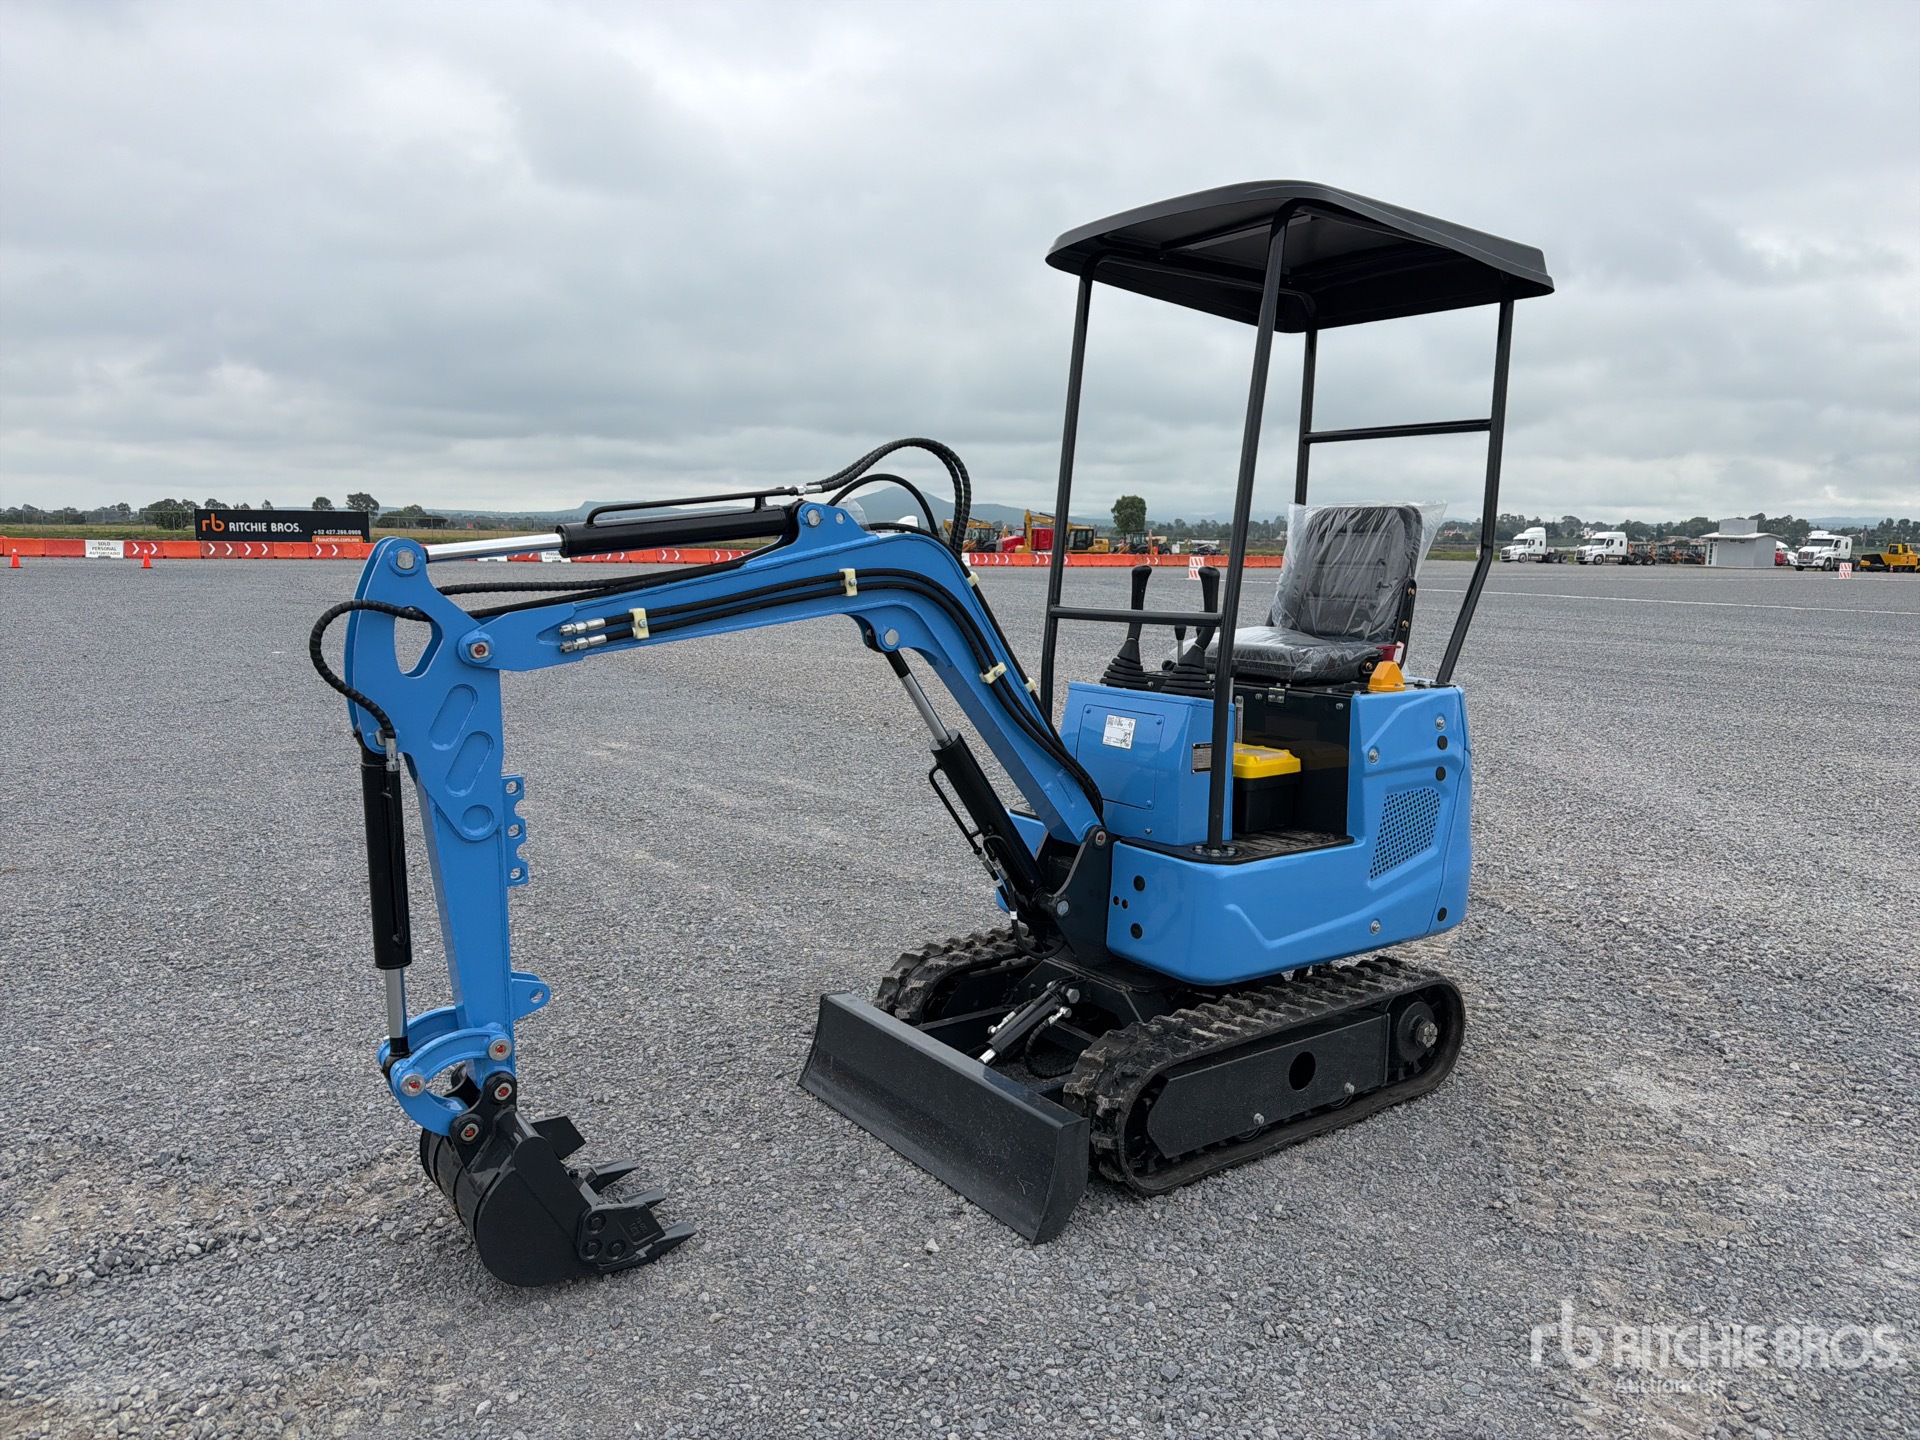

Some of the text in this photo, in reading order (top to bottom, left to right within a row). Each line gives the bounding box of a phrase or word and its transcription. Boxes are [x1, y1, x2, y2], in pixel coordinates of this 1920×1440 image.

[202, 513, 303, 533] rb RITCHIE BROS.
